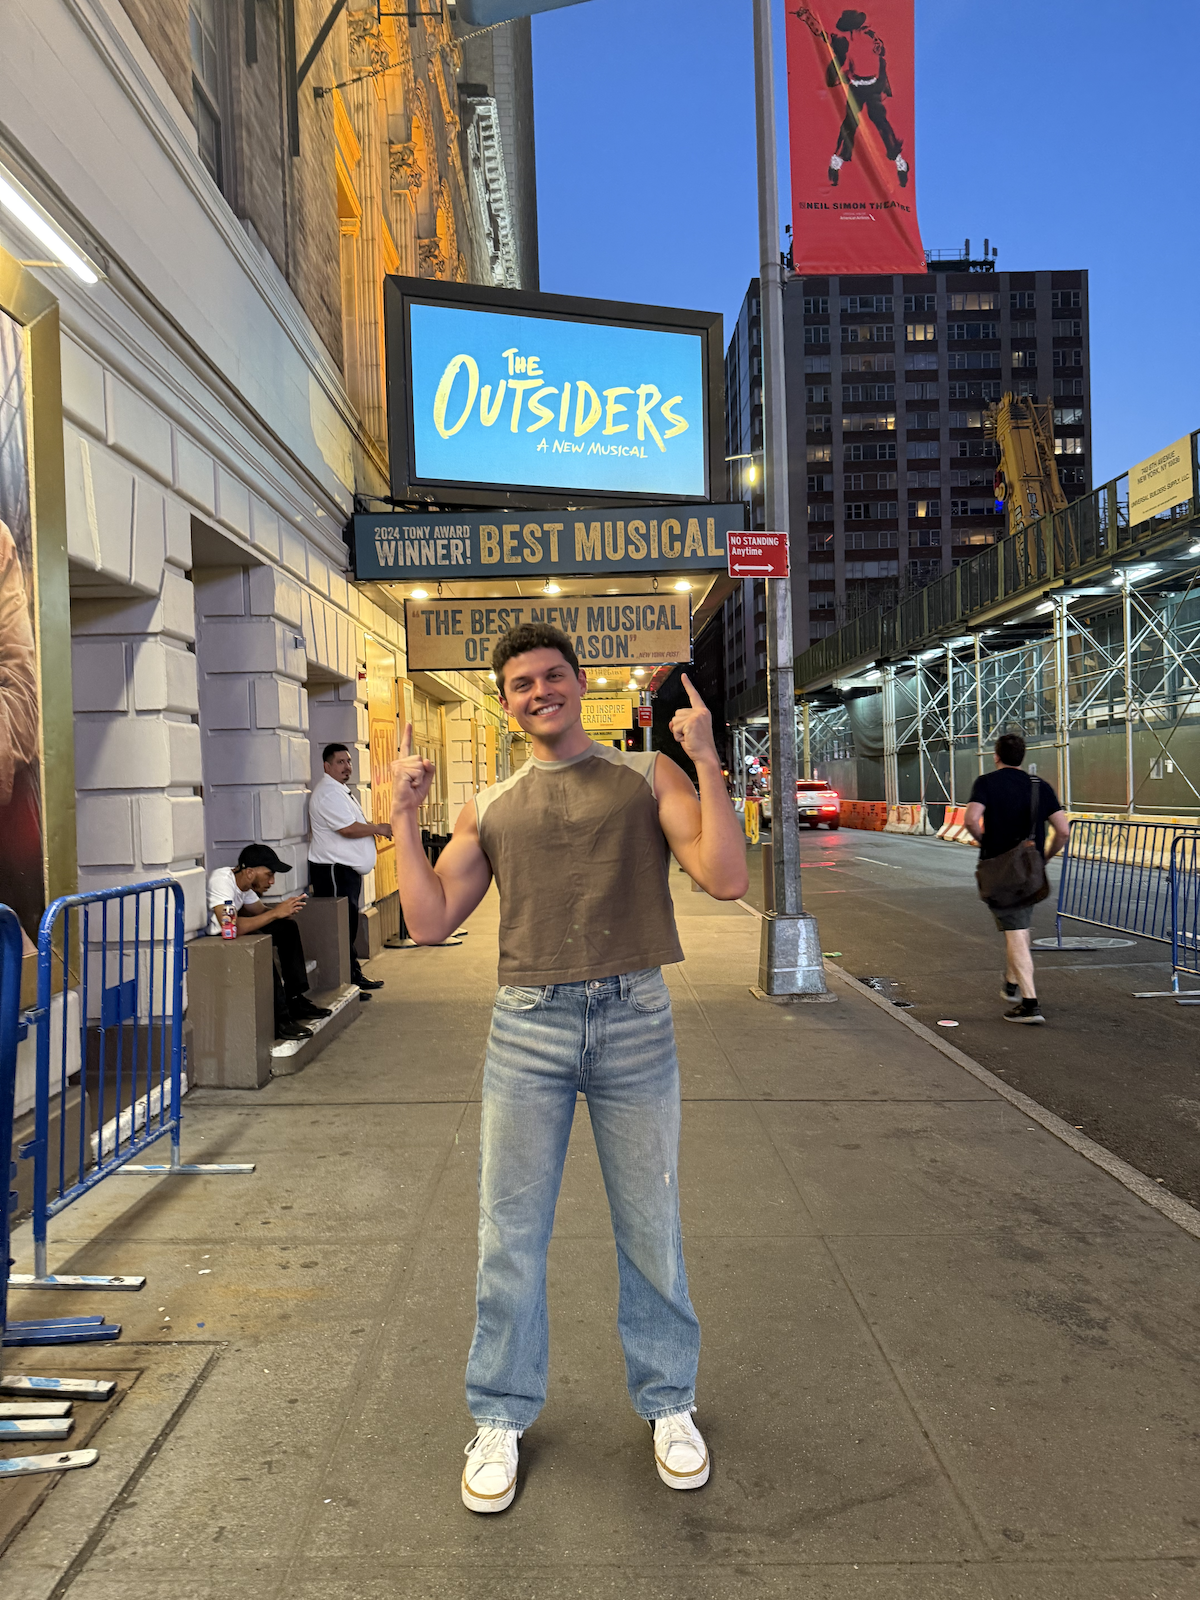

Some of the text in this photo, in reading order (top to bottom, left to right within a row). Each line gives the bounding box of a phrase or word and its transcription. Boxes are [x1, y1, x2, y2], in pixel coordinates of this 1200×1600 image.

[806, 200, 911, 213] NEIL SIMON THEATRE
[501, 347, 544, 376] THE
[433, 353, 690, 453] OUTSIDERS
[536, 437, 649, 459] A NEW MUSICAL
[1158, 450, 1175, 465] AVENUE
[1137, 474, 1147, 484] NEW
[1160, 463, 1167, 472] NY
[1149, 485, 1167, 498] BUILDERS
[374, 525, 470, 540] 2024 TONY AWARD
[479, 517, 725, 564] BEST MUSICAL
[730, 536, 780, 546] NO STANDING
[374, 539, 472, 567] WINNER!
[731, 546, 763, 558] Anytime
[470, 608, 524, 635] BEST
[587, 604, 682, 632] MUSICAL
[464, 634, 637, 662] OF ASON.”
[584, 704, 626, 714] TO INSPIRE
